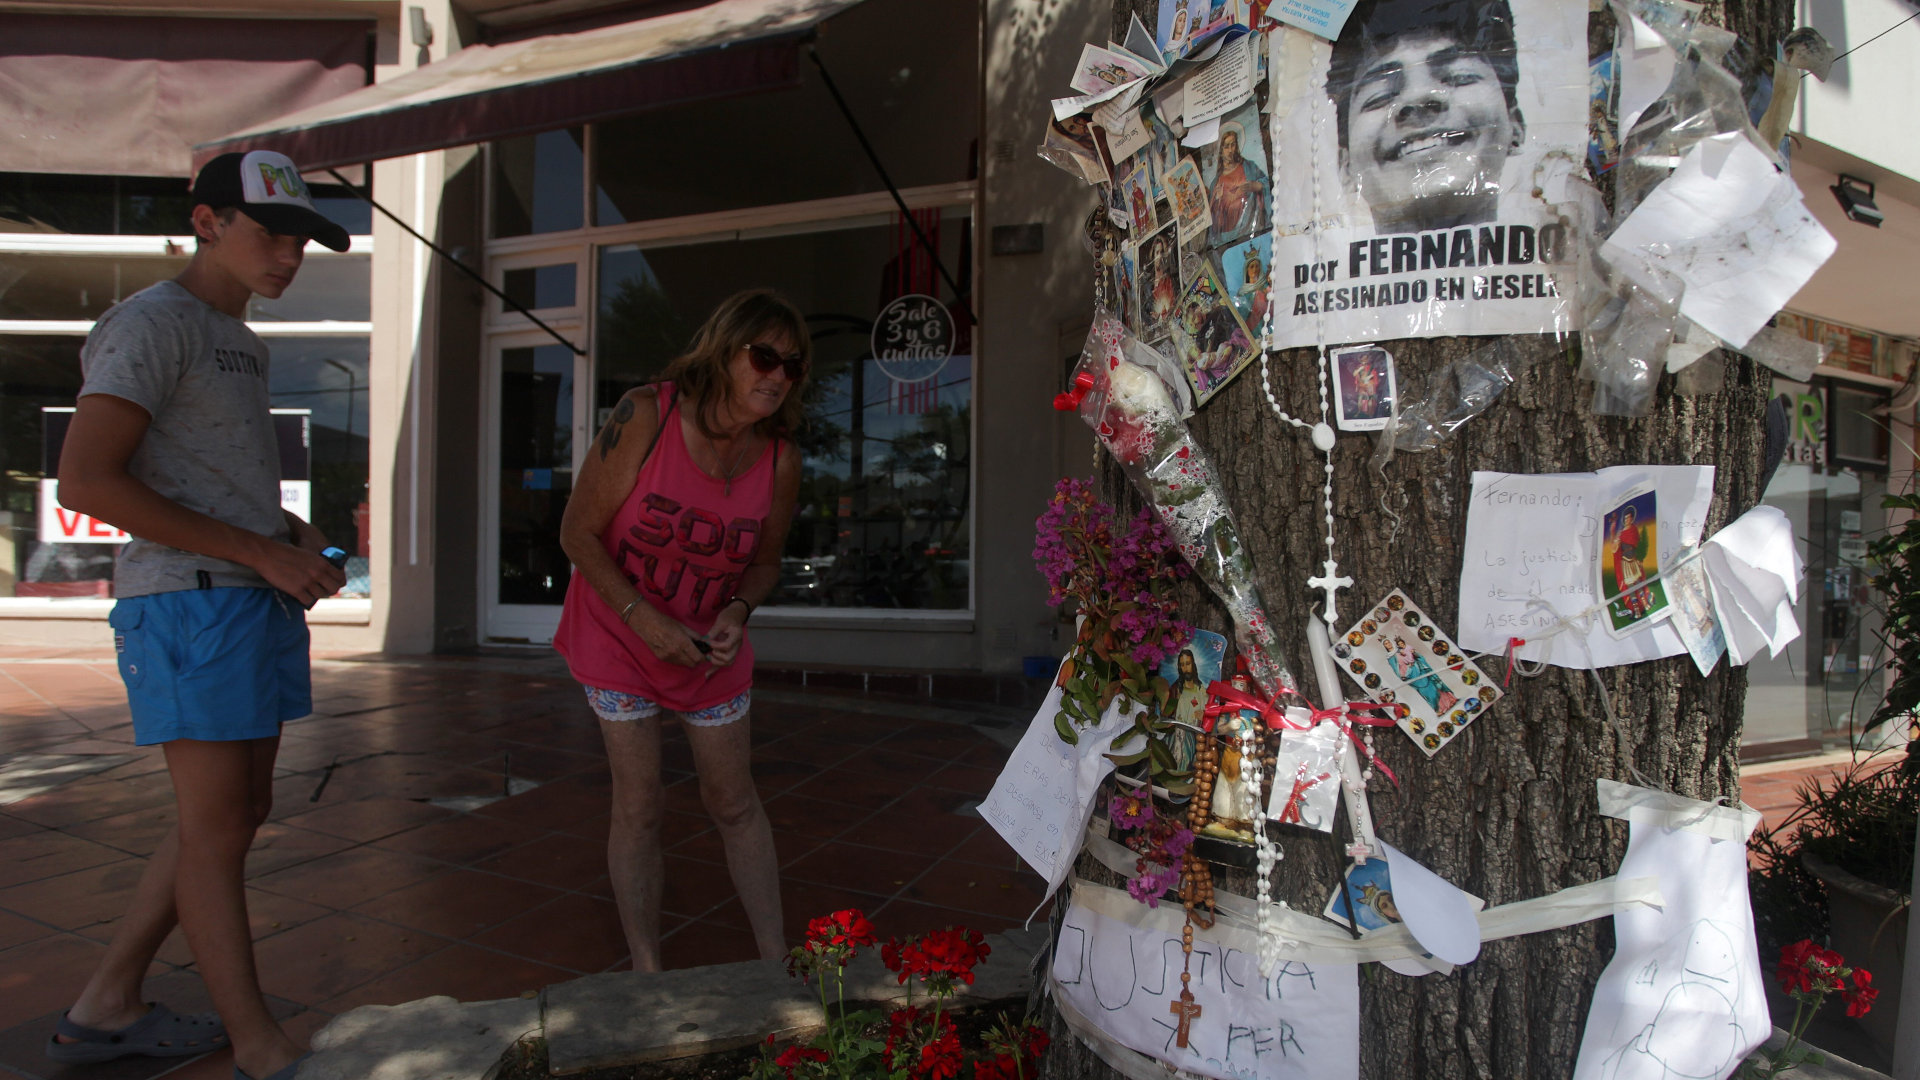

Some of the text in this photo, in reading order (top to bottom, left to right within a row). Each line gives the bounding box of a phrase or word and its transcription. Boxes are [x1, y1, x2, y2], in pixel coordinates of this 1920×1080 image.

[257, 162, 309, 198] PU
[1294, 258, 1339, 289] por
[1349, 224, 1567, 279] FERNANDO
[1292, 278, 1428, 316] ASESINADO
[1435, 275, 1465, 302] EN
[887, 301, 937, 325] Sale
[886, 323, 902, 343] 3
[922, 320, 941, 340] 6
[882, 340, 946, 363] cuotas
[55, 507, 126, 537] VE
[1484, 613, 1567, 630] ASESINO
[1226, 1019, 1304, 1061] FER
